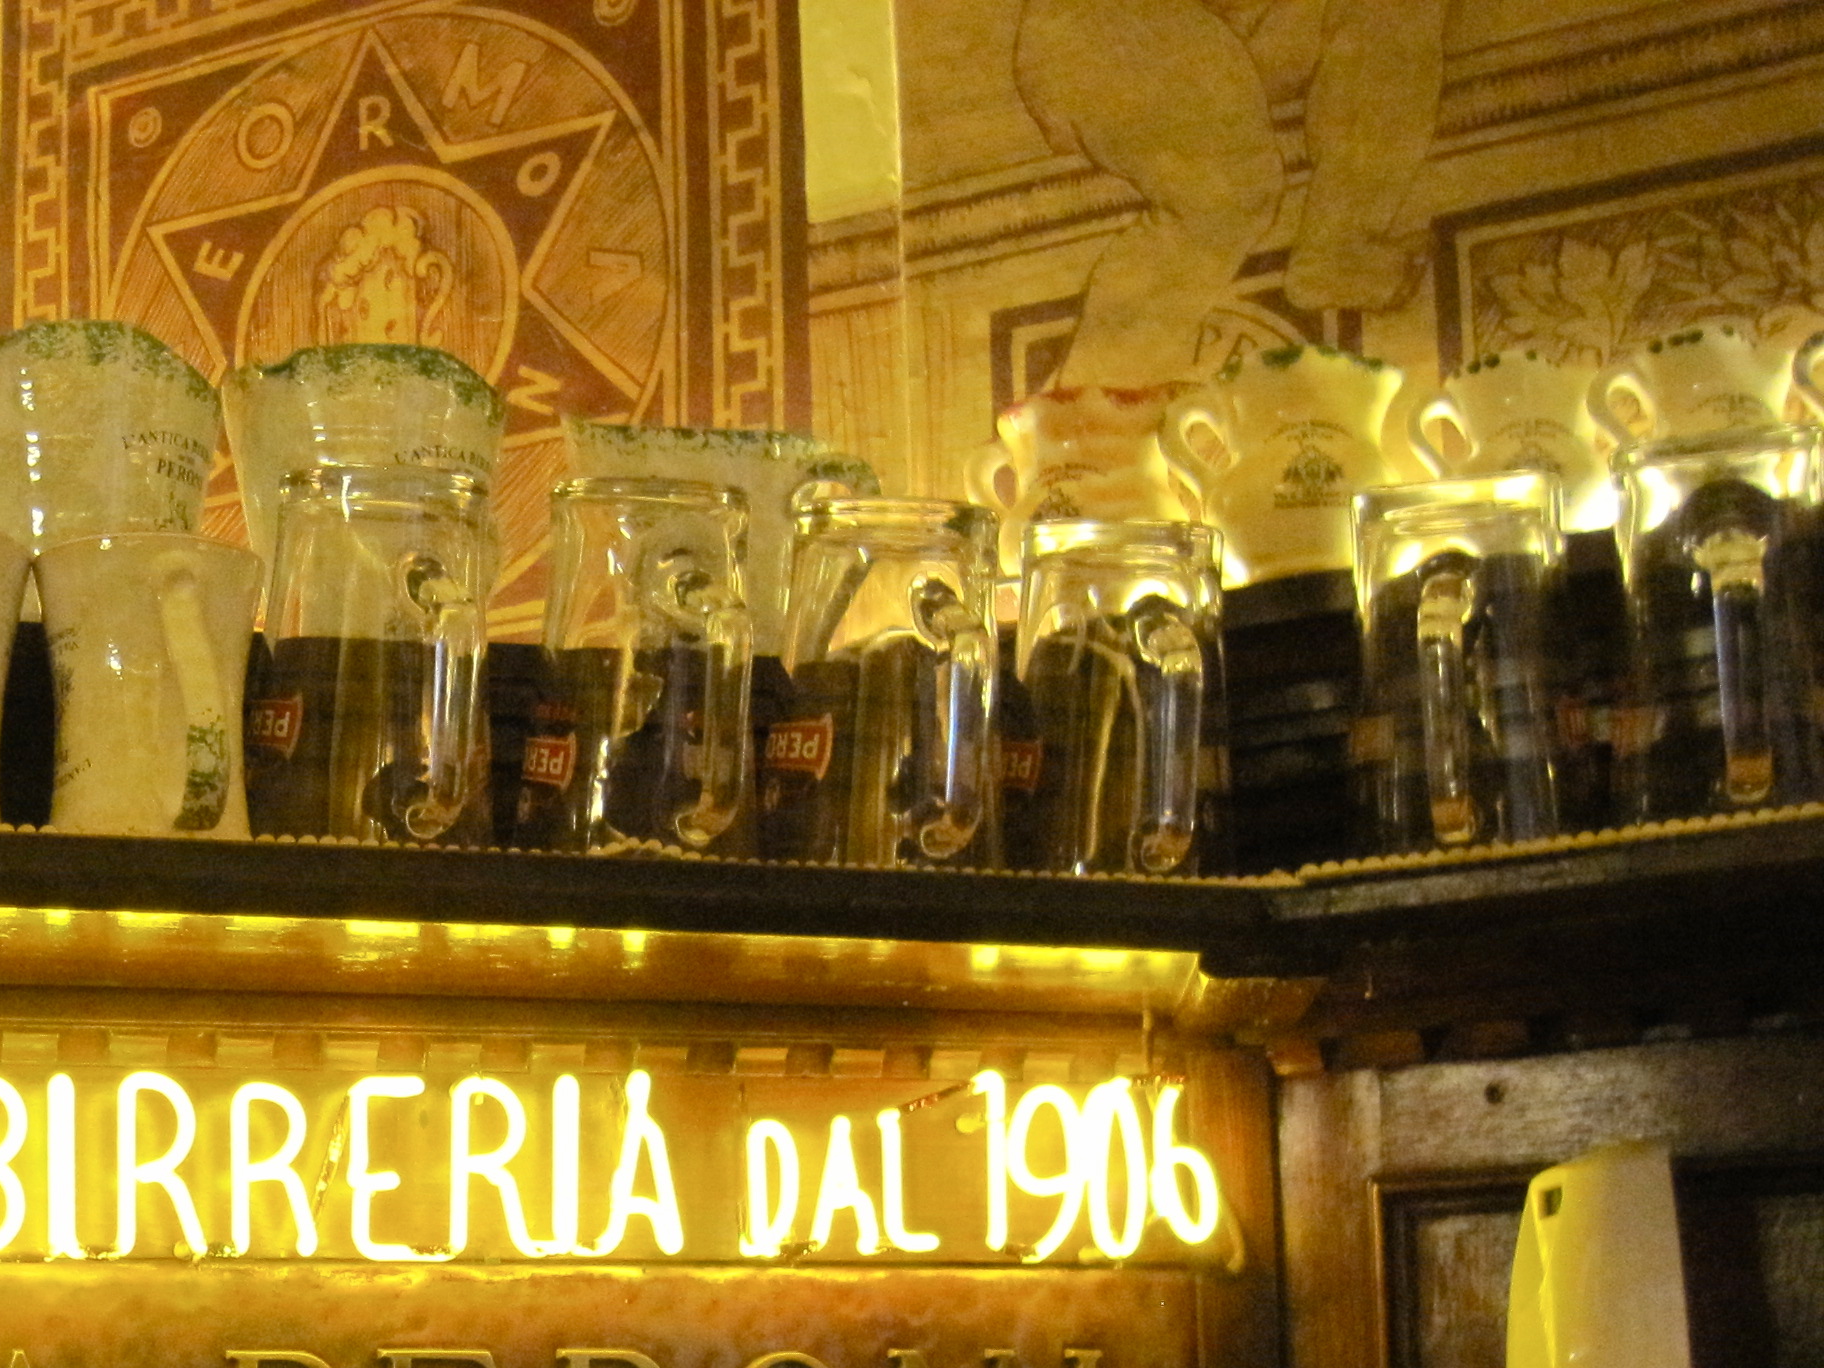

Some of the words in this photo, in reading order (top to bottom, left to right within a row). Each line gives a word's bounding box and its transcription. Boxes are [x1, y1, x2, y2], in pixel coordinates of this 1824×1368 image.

[121, 430, 189, 450] L'ANTICA
[394, 445, 466, 465] L'ANTICA
[740, 1107, 942, 1258] DAL
[970, 1068, 1223, 1264] 1906
